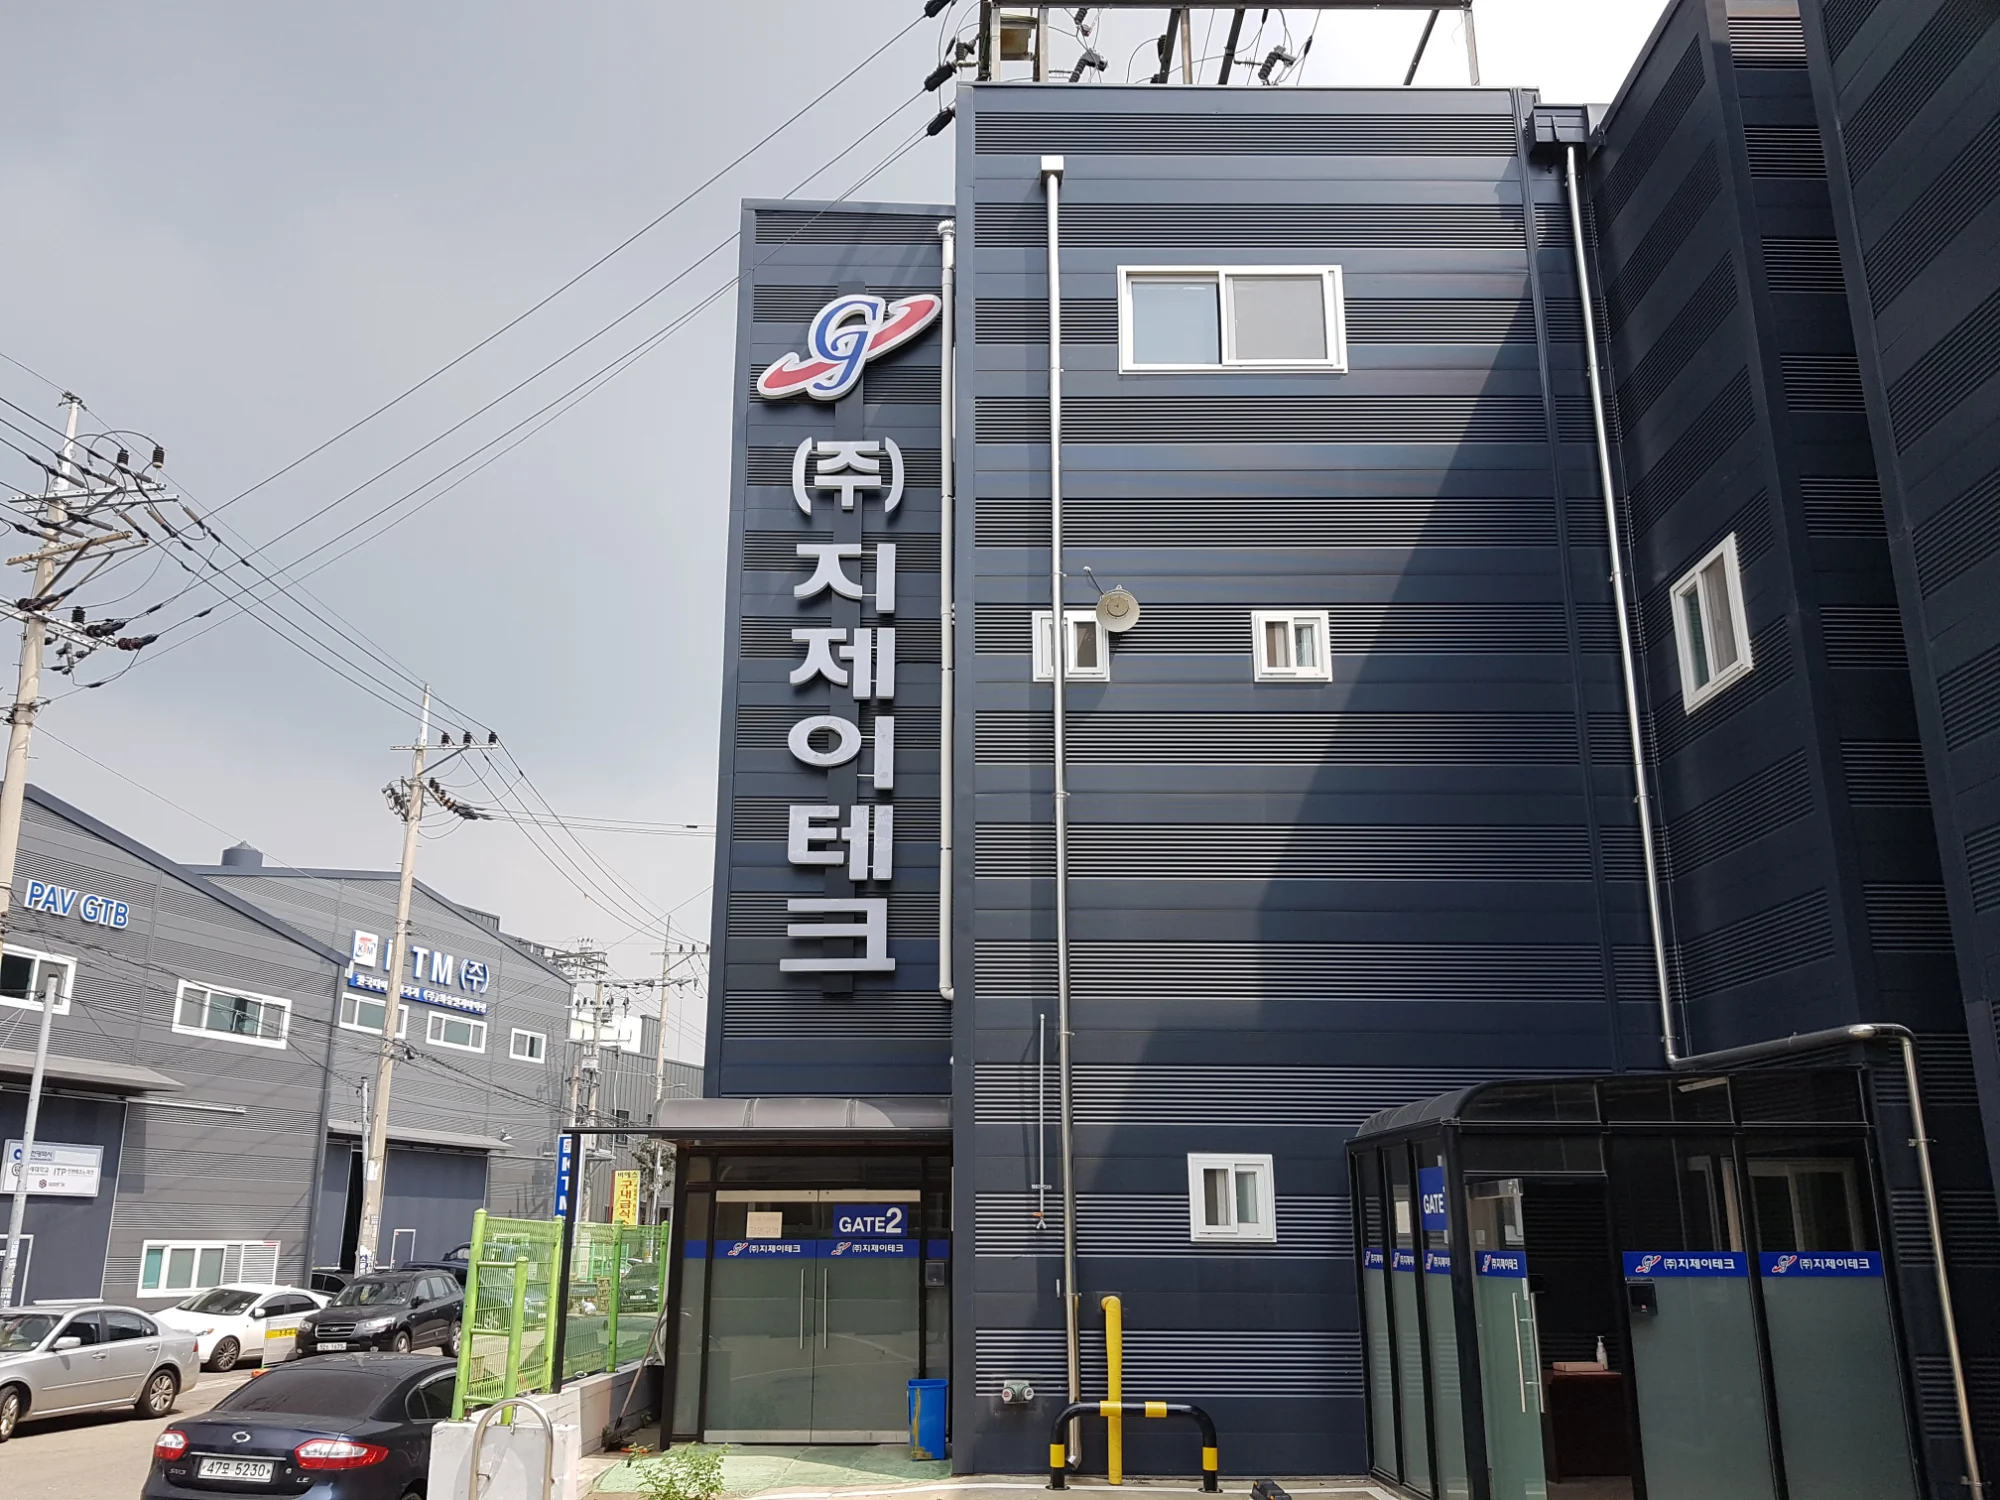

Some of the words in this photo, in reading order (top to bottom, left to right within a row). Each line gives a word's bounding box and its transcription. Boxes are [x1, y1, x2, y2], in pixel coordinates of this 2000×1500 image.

[24, 880, 79, 916] PAV
[80, 894, 129, 929] GTB
[460, 958, 490, 994] (주)
[1423, 1186, 1446, 1214] GATE
[235, 1462, 265, 1477] 5230
